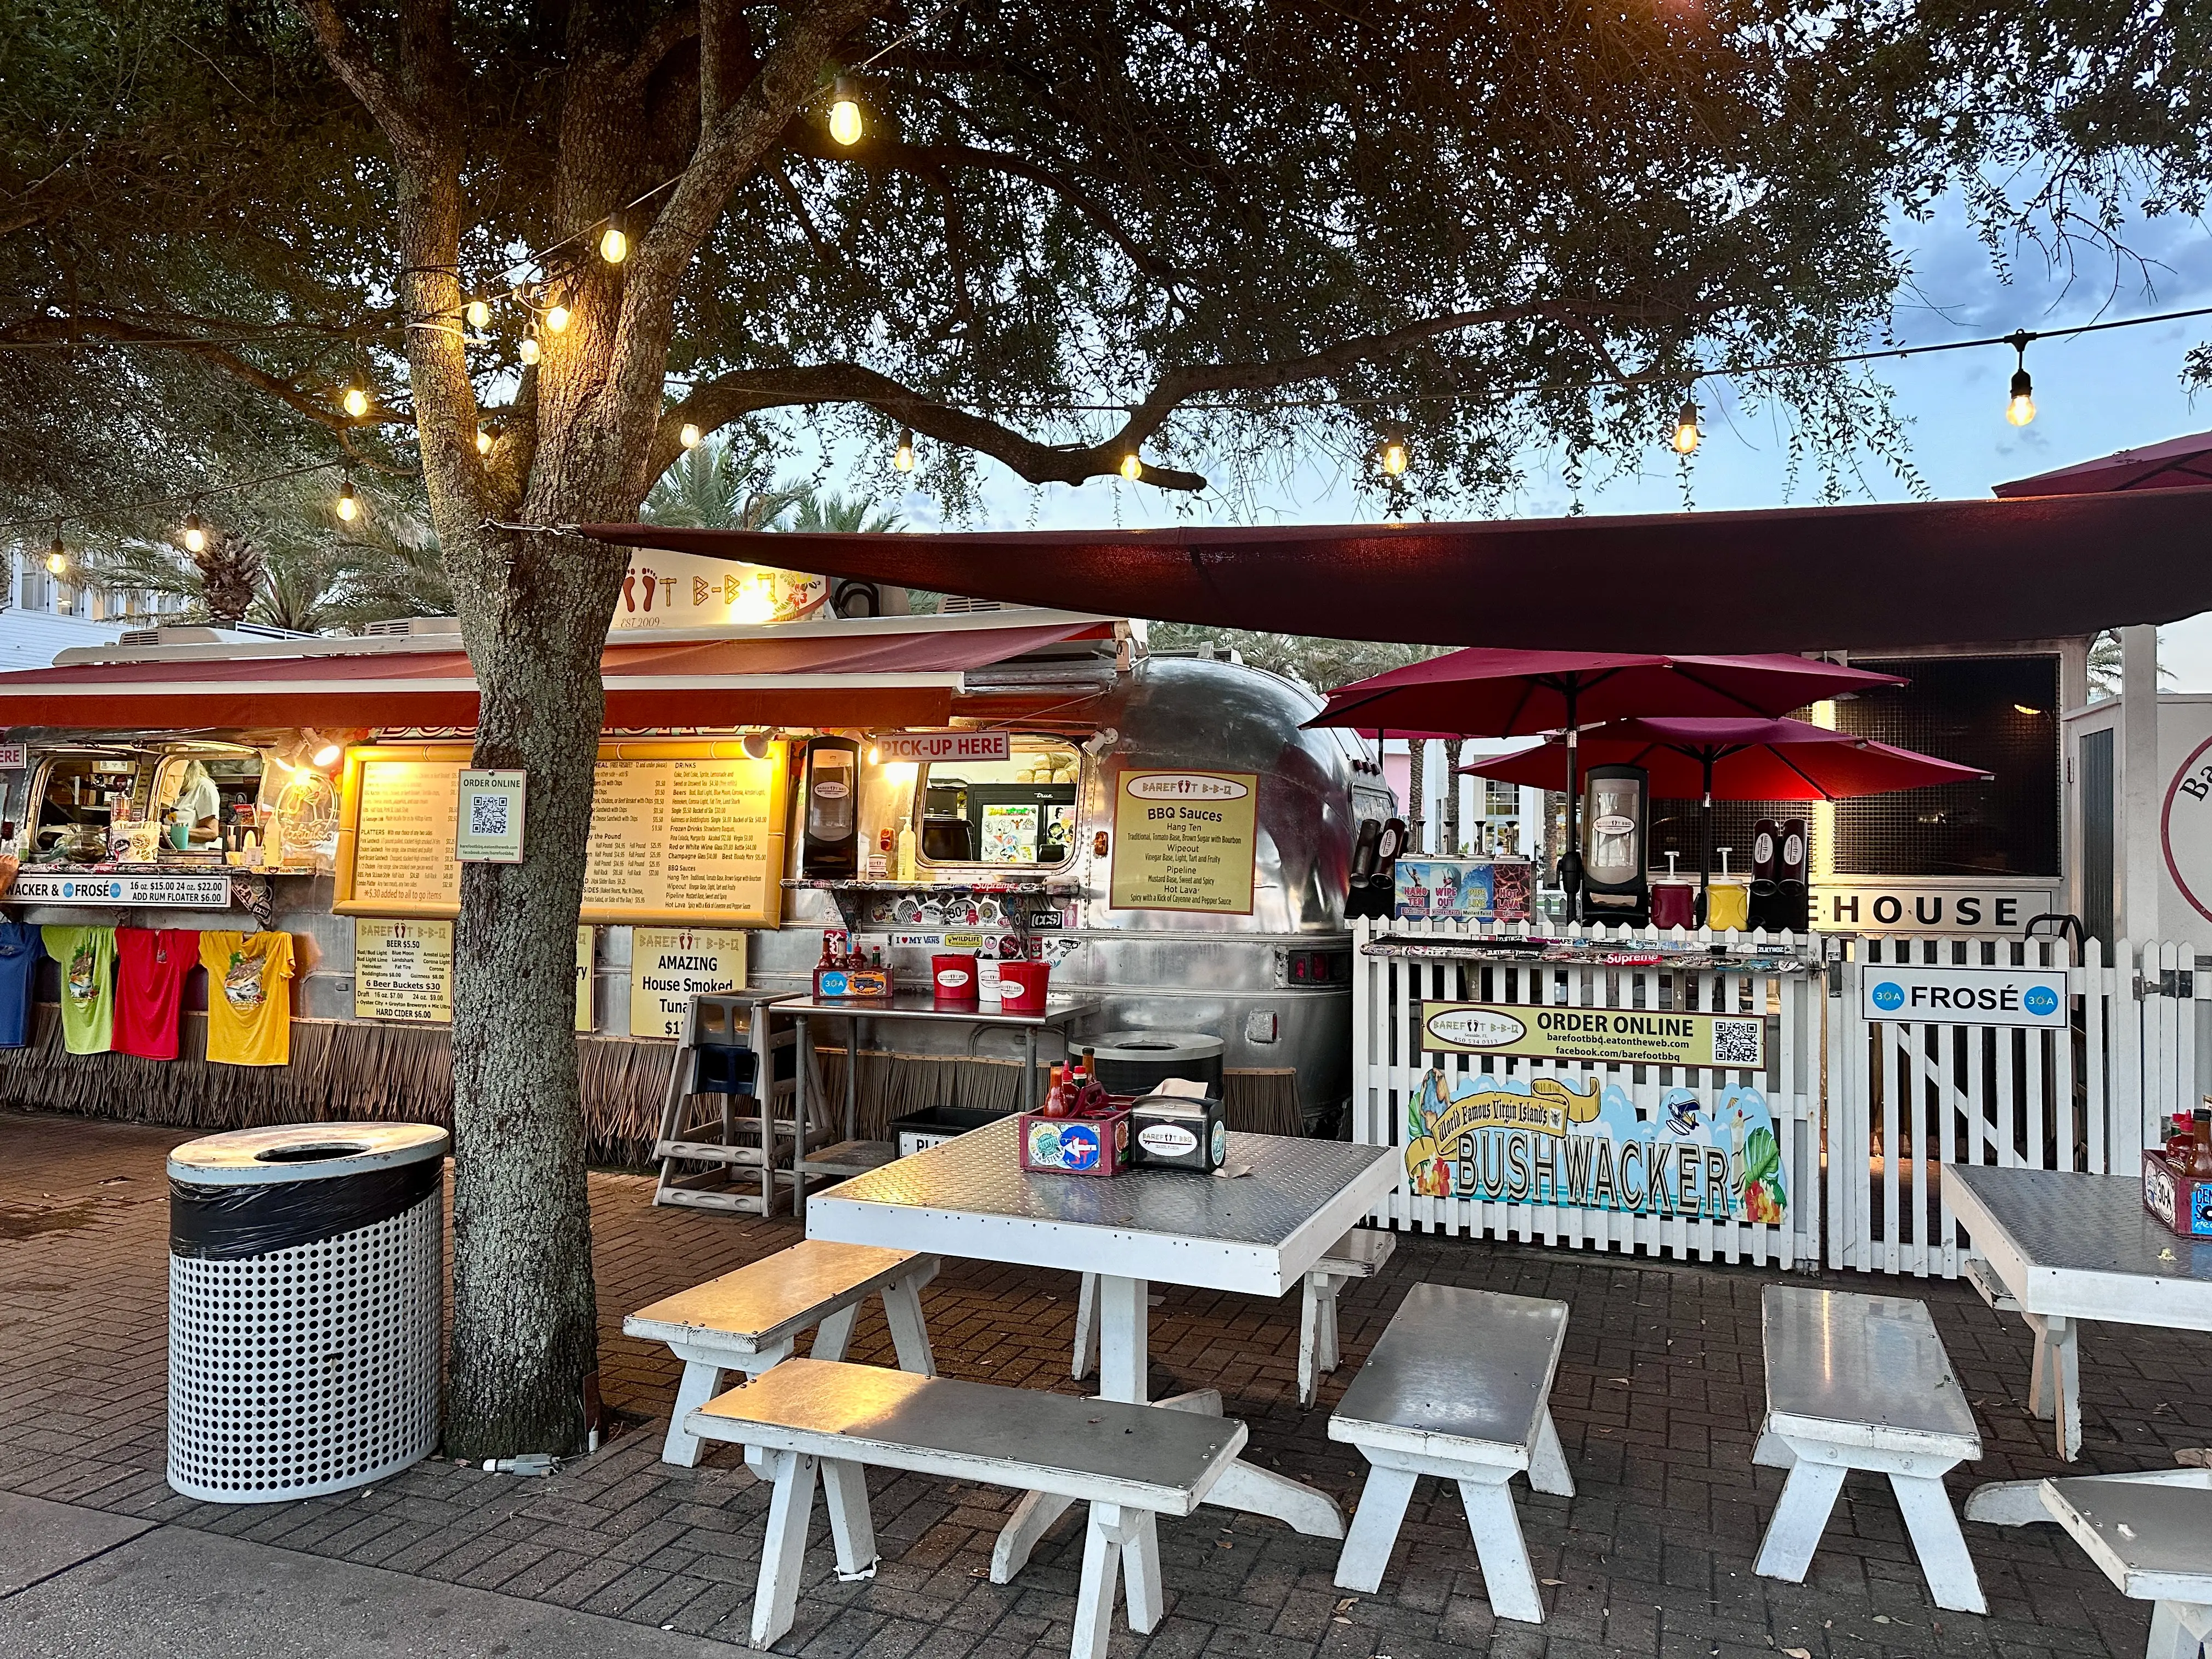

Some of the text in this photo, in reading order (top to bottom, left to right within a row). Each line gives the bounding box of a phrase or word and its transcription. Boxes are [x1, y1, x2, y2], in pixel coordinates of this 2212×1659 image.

[621, 617, 659, 627] EST 2009
[882, 738, 1003, 756] PICK-UP HERE
[1148, 807, 1222, 822] BBQ Sauces
[1167, 823, 1186, 832] Hang
[1170, 833, 1181, 842] Base,
[1167, 844, 1199, 853] Wipeout
[1146, 853, 1161, 862] Vinegar
[1175, 854, 1187, 862] Light,
[1207, 855, 1220, 864] Fruity
[1167, 866, 1196, 874] Pipeline
[52, 884, 59, 896] &
[76, 881, 109, 896] FROSÉ
[131, 882, 138, 890] 16
[150, 882, 174, 891] $15.00
[198, 883, 222, 891] $22.00
[1404, 887, 1427, 895] HANG
[168, 893, 199, 901] FLOATER
[201, 894, 221, 902] $6.00
[381, 890, 397, 899] added
[399, 890, 403, 899] to
[413, 890, 417, 899] to
[419, 893, 425, 901] go
[427, 890, 441, 899] items
[1436, 888, 1457, 907] WIPE OUT
[1497, 889, 1520, 909] HOT LAVA
[1468, 899, 1486, 907] LINE
[658, 956, 717, 971] AMAZING
[1607, 954, 1657, 964] Supreme
[643, 977, 732, 992] House Smoked
[1911, 984, 2019, 1011] FROSÉ
[1538, 1013, 1694, 1037] ORDER ONLINE
[1547, 1034, 1689, 1048] barefootbbq.eatontheweb.com
[1556, 1047, 1680, 1062] facebook.com/barefootbbq
[1438, 1099, 1548, 1142] World Famous Virgin Island's
[1456, 1130, 1730, 1218] BUSHWACKER
[2158, 1182, 2171, 1211] 30-A
